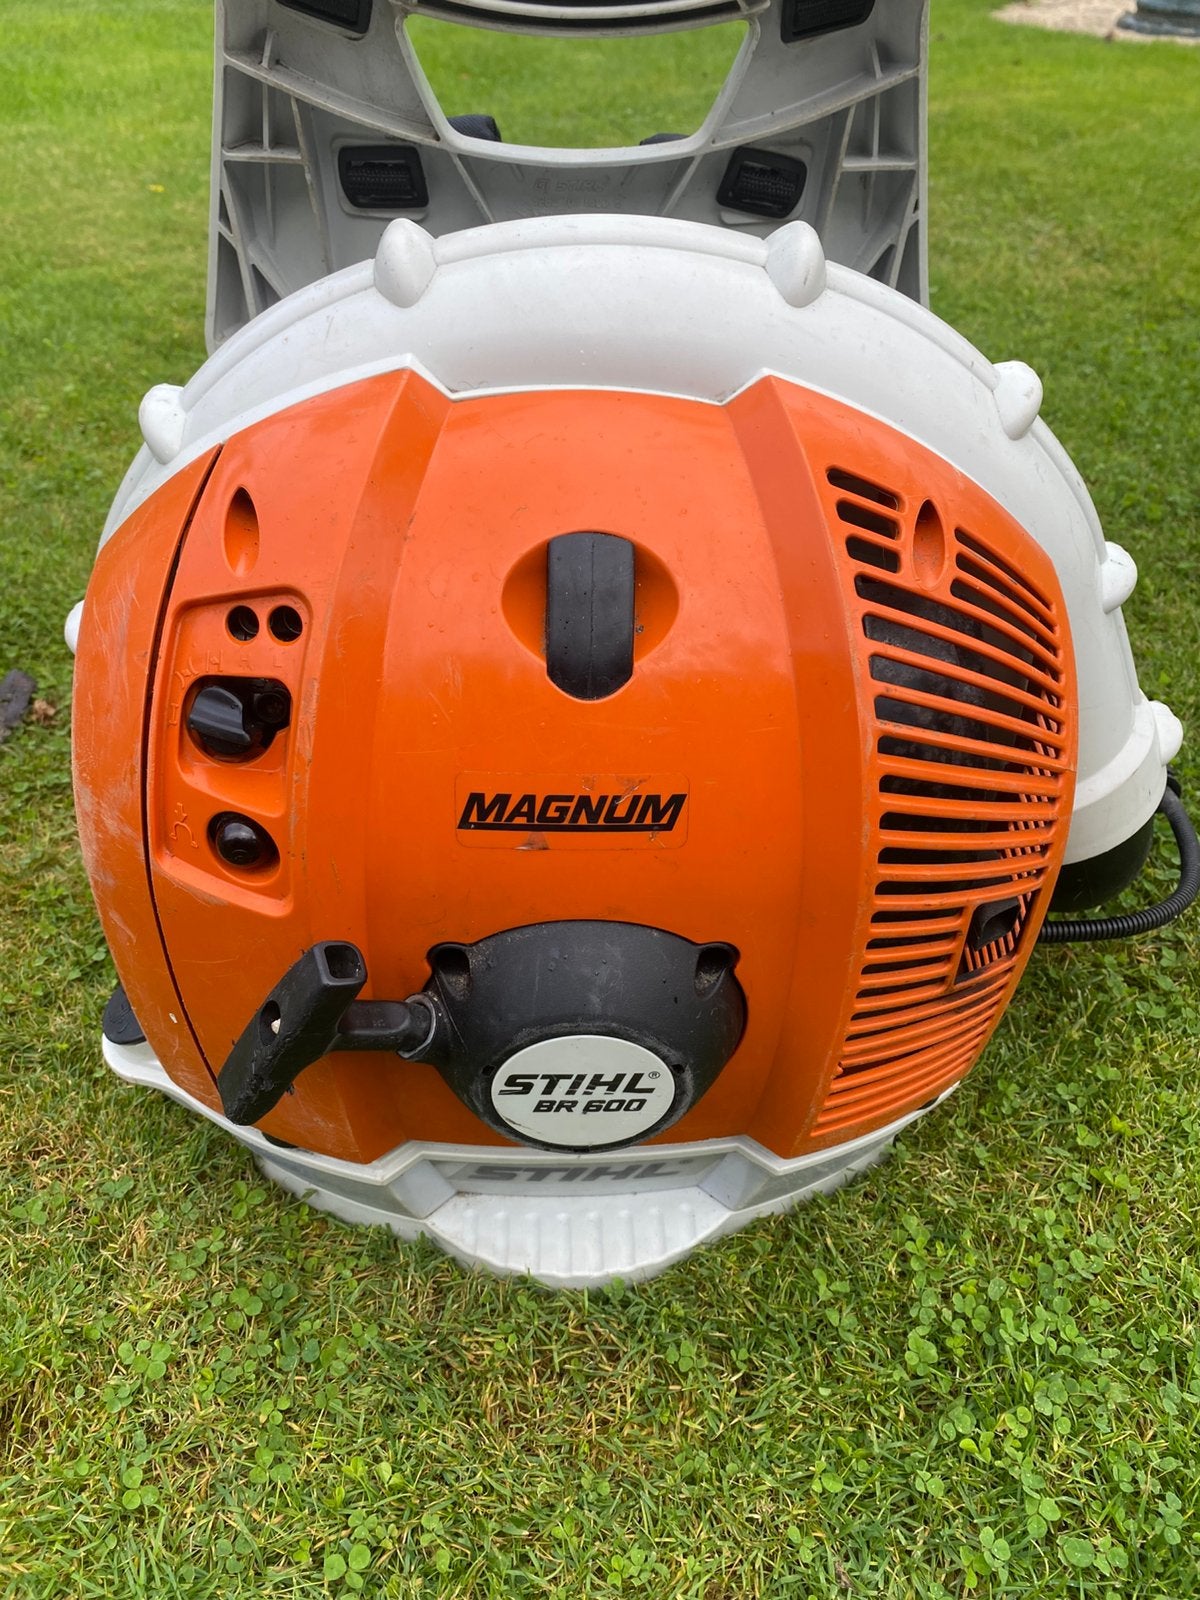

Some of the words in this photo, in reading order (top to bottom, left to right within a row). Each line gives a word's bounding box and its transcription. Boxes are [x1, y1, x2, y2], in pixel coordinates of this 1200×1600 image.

[457, 792, 688, 831] MAGNUM
[532, 1099, 579, 1113] BR
[582, 1098, 648, 1115] 600
